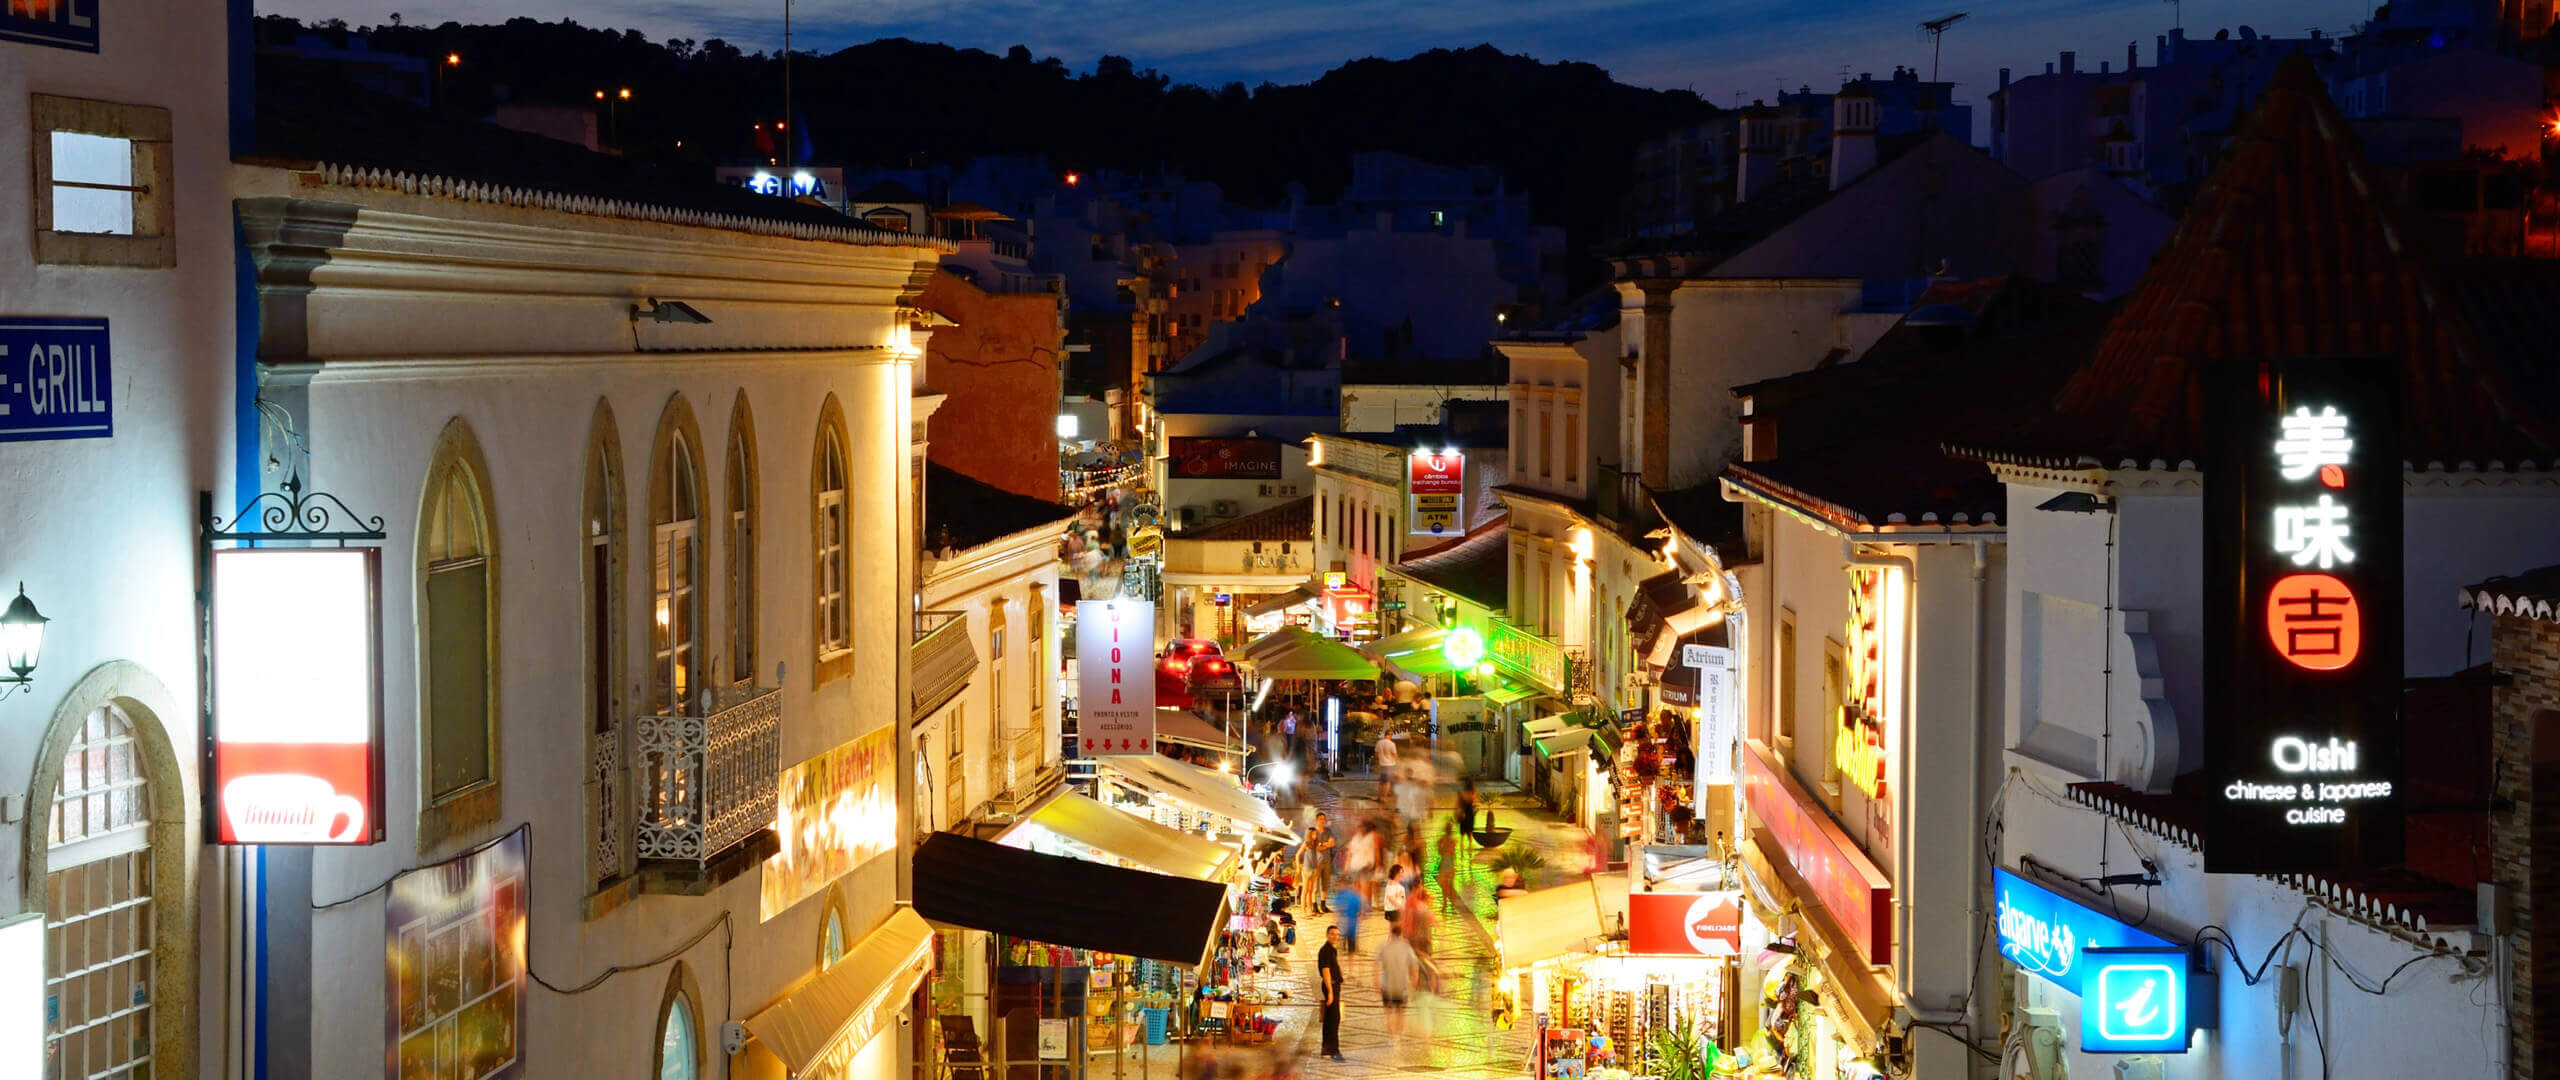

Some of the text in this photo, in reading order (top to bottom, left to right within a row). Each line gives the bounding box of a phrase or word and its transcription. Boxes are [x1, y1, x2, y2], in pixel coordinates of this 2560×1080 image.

[1224, 461, 1277, 471] IMAGINE
[1687, 648, 1724, 665] Atrium
[2272, 736, 2357, 772] Oishi
[2225, 779, 2392, 803] chinese & japanese
[2285, 806, 2346, 825] cuisine
[1998, 889, 2051, 960] algarve
